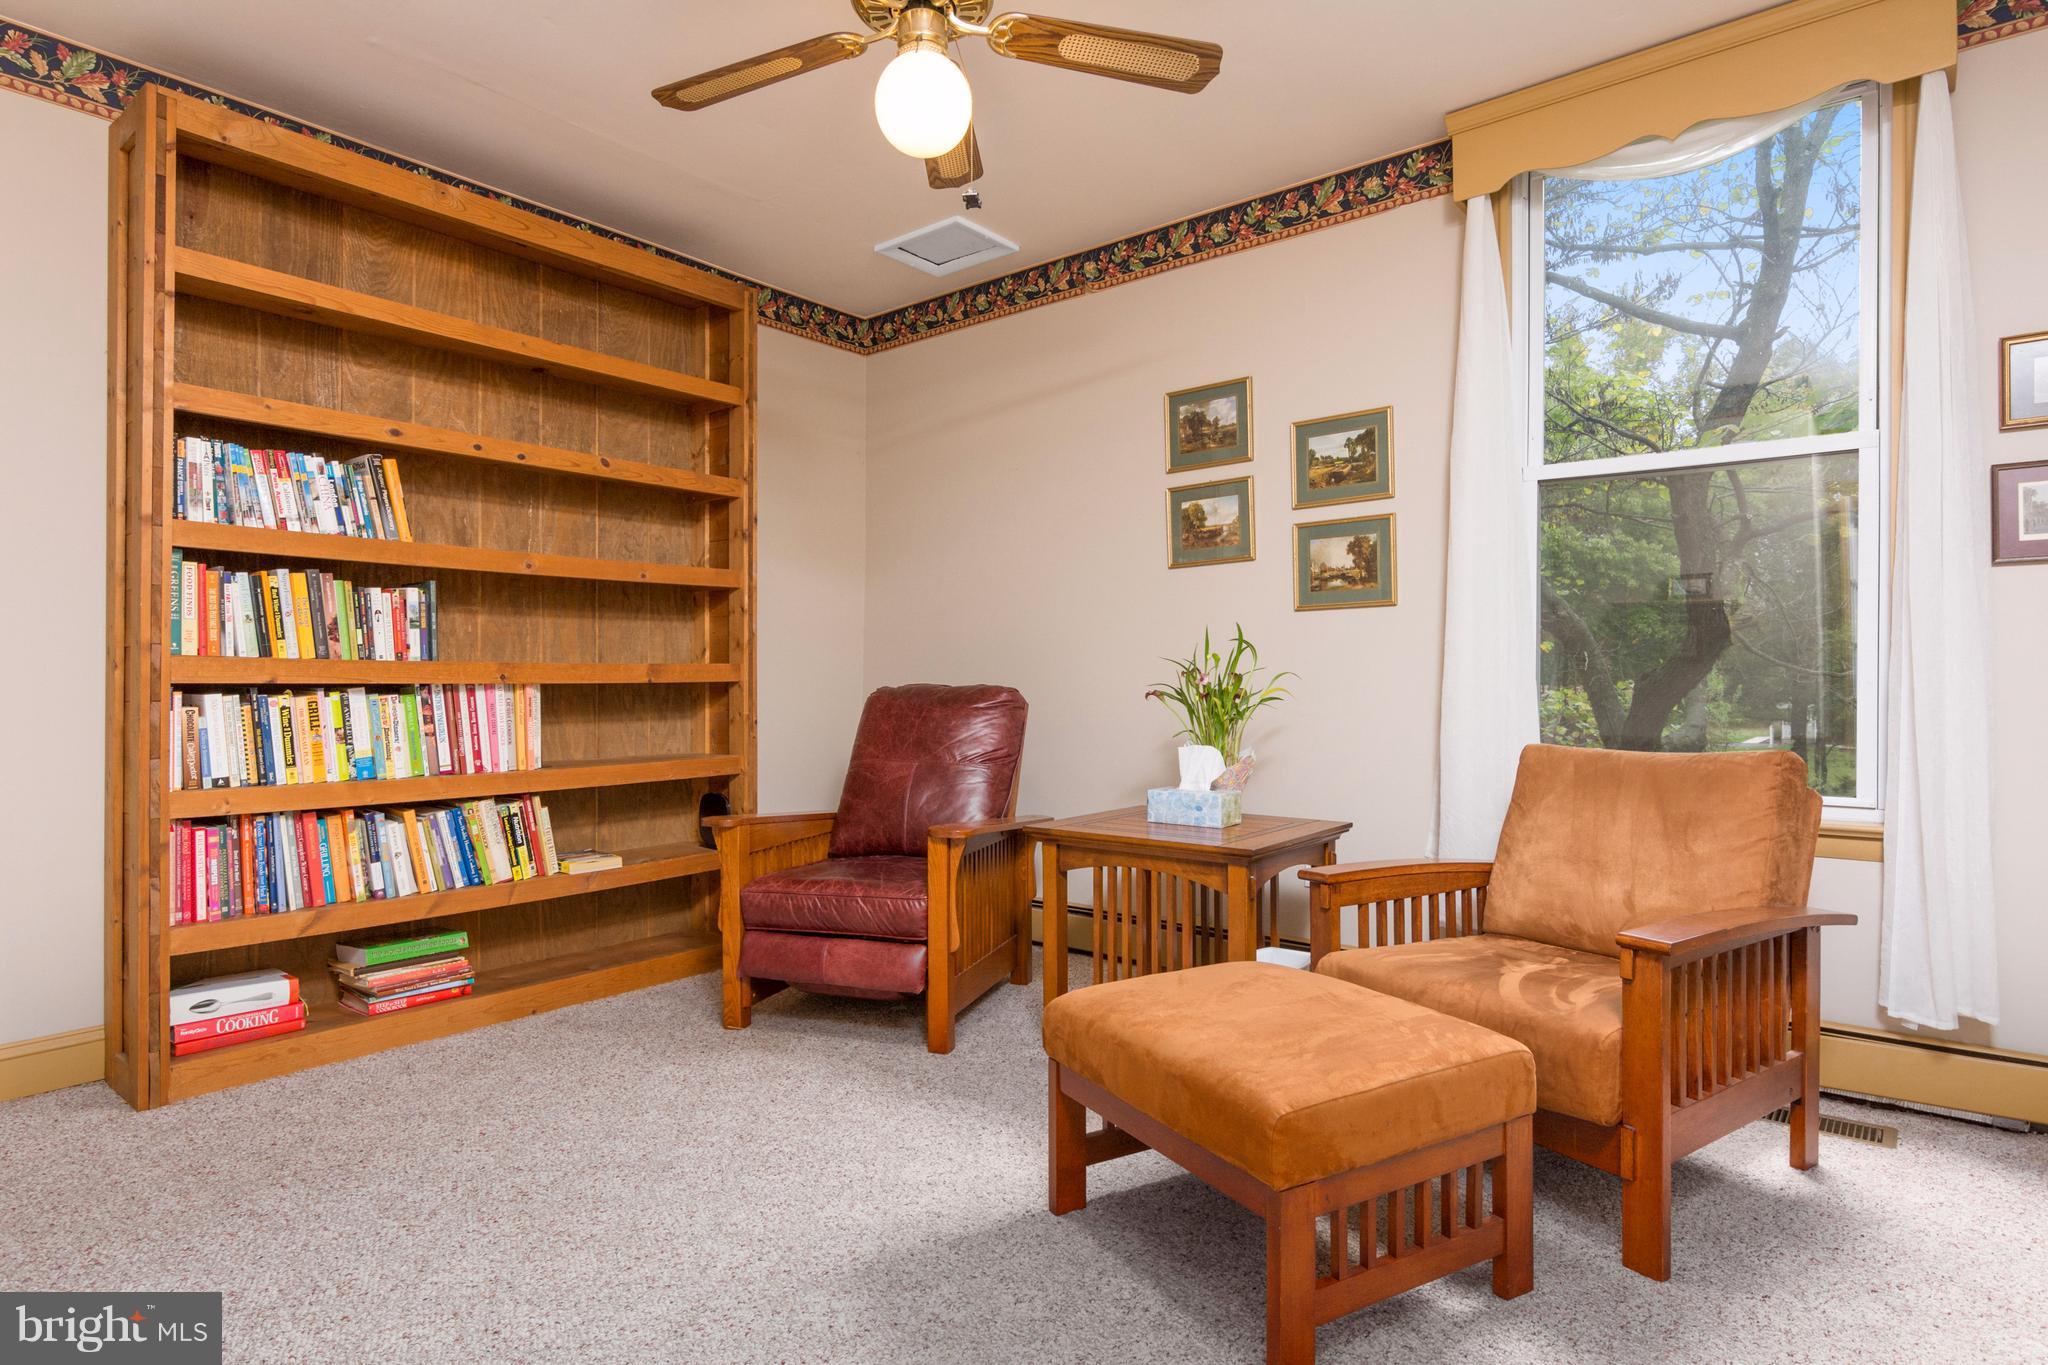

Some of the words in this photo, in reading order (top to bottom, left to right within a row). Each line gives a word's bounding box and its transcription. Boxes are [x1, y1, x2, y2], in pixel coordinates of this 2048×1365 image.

[330, 480, 340, 508] London
[185, 710, 196, 742] CHOCOLATE
[282, 709, 291, 727] Wine
[308, 701, 320, 731] GRILL
[283, 731, 294, 765] Dummies
[513, 817, 523, 843] Nutrition
[320, 842, 331, 877] GRILLING
[216, 1009, 279, 1034] COOKING
